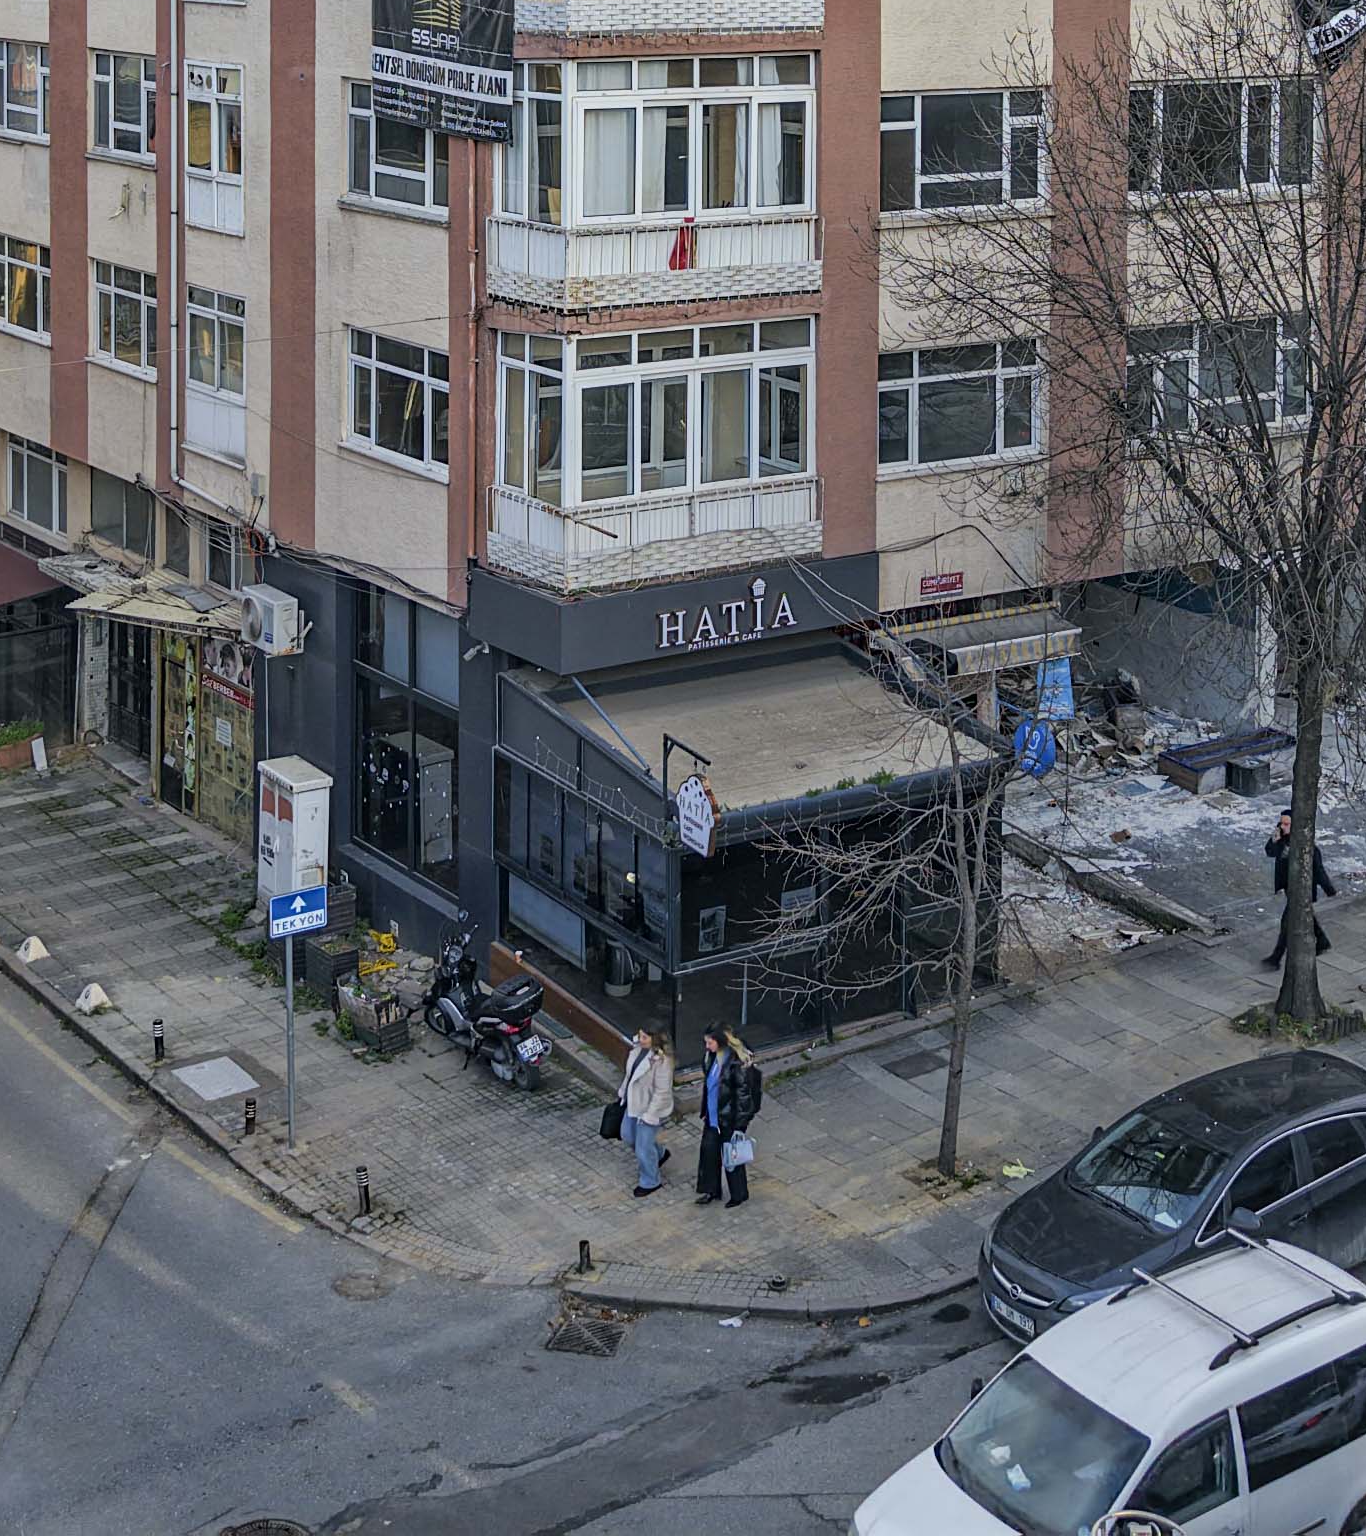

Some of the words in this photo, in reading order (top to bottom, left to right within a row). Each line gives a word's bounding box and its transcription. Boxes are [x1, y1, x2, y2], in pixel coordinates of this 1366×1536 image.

[372, 53, 405, 77] ENTSEL
[406, 58, 446, 85] DÖNÜŞÜM
[447, 68, 475, 93] PROJE
[275, 917, 297, 933] TEK
